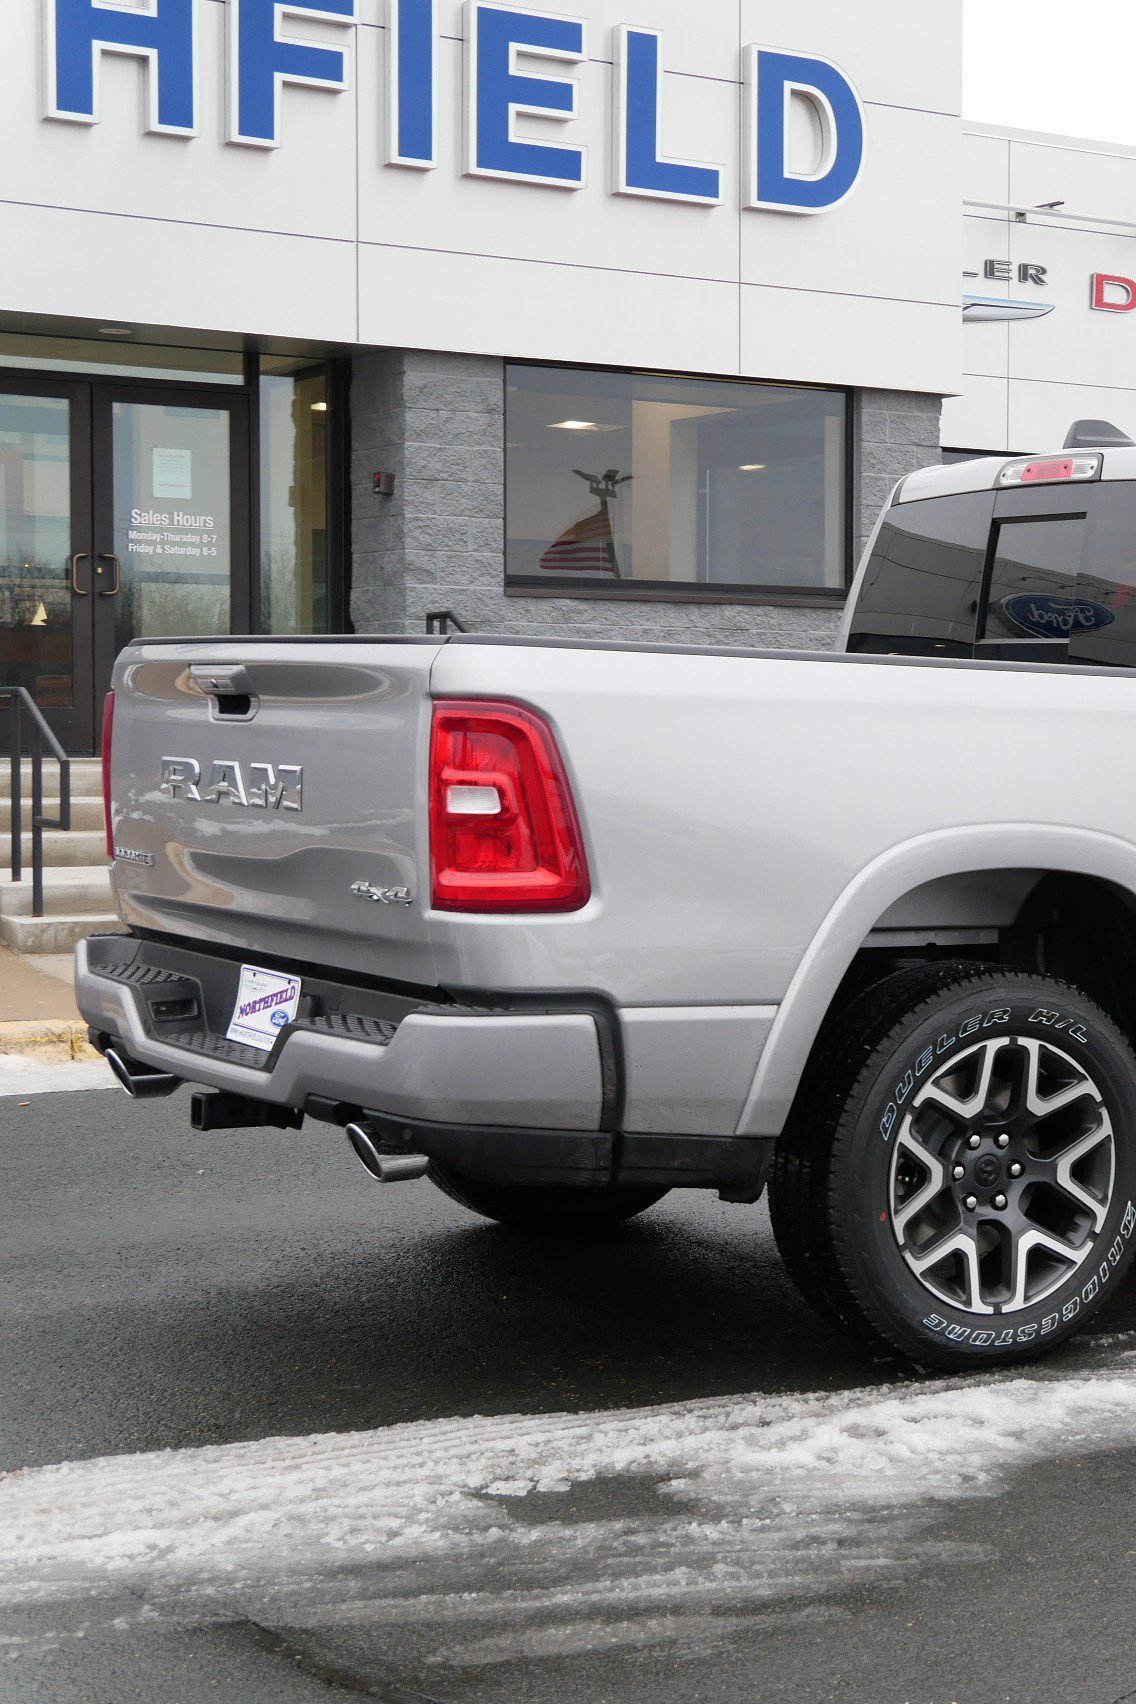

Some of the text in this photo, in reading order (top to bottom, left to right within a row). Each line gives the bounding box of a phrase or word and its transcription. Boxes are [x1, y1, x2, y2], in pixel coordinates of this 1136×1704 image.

[43, 0, 868, 215] HFIELD
[962, 258, 1048, 286] ER
[130, 508, 214, 528] Sales Hours
[128, 530, 217, 544] Monday-Thursday 8-7
[128, 543, 217, 557] Friday & Saturday 8-5
[161, 755, 304, 812] RAM
[237, 985, 296, 1020] NORTHFIELD
[880, 1006, 1090, 1141] DUELER H/L
